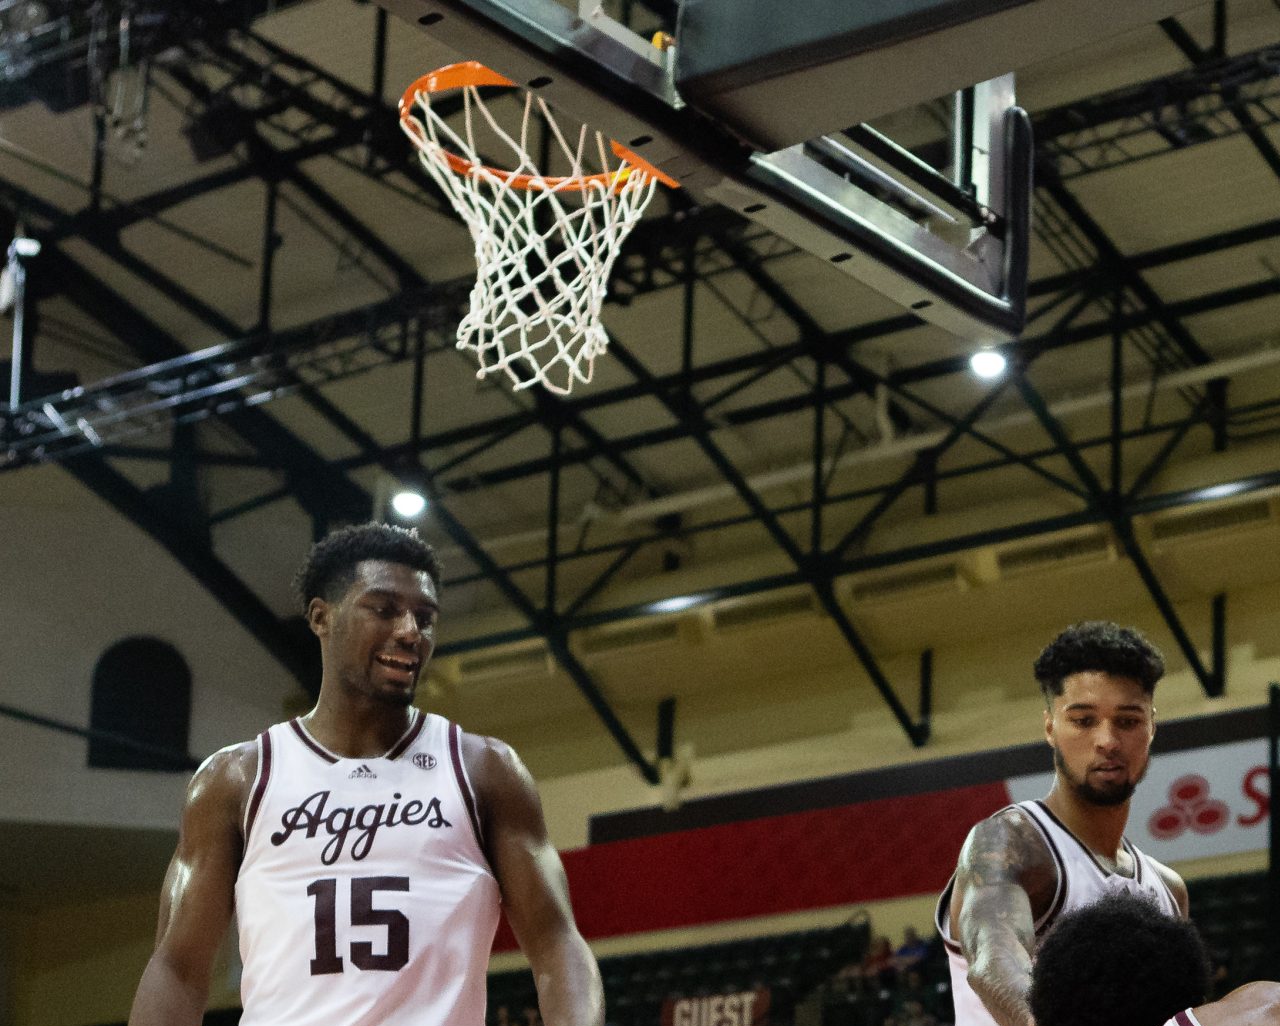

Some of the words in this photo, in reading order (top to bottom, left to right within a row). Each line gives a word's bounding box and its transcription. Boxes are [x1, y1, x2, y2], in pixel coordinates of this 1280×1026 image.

[414, 753, 435, 769] SEC
[270, 791, 453, 866] Aggies
[306, 876, 410, 976] 15
